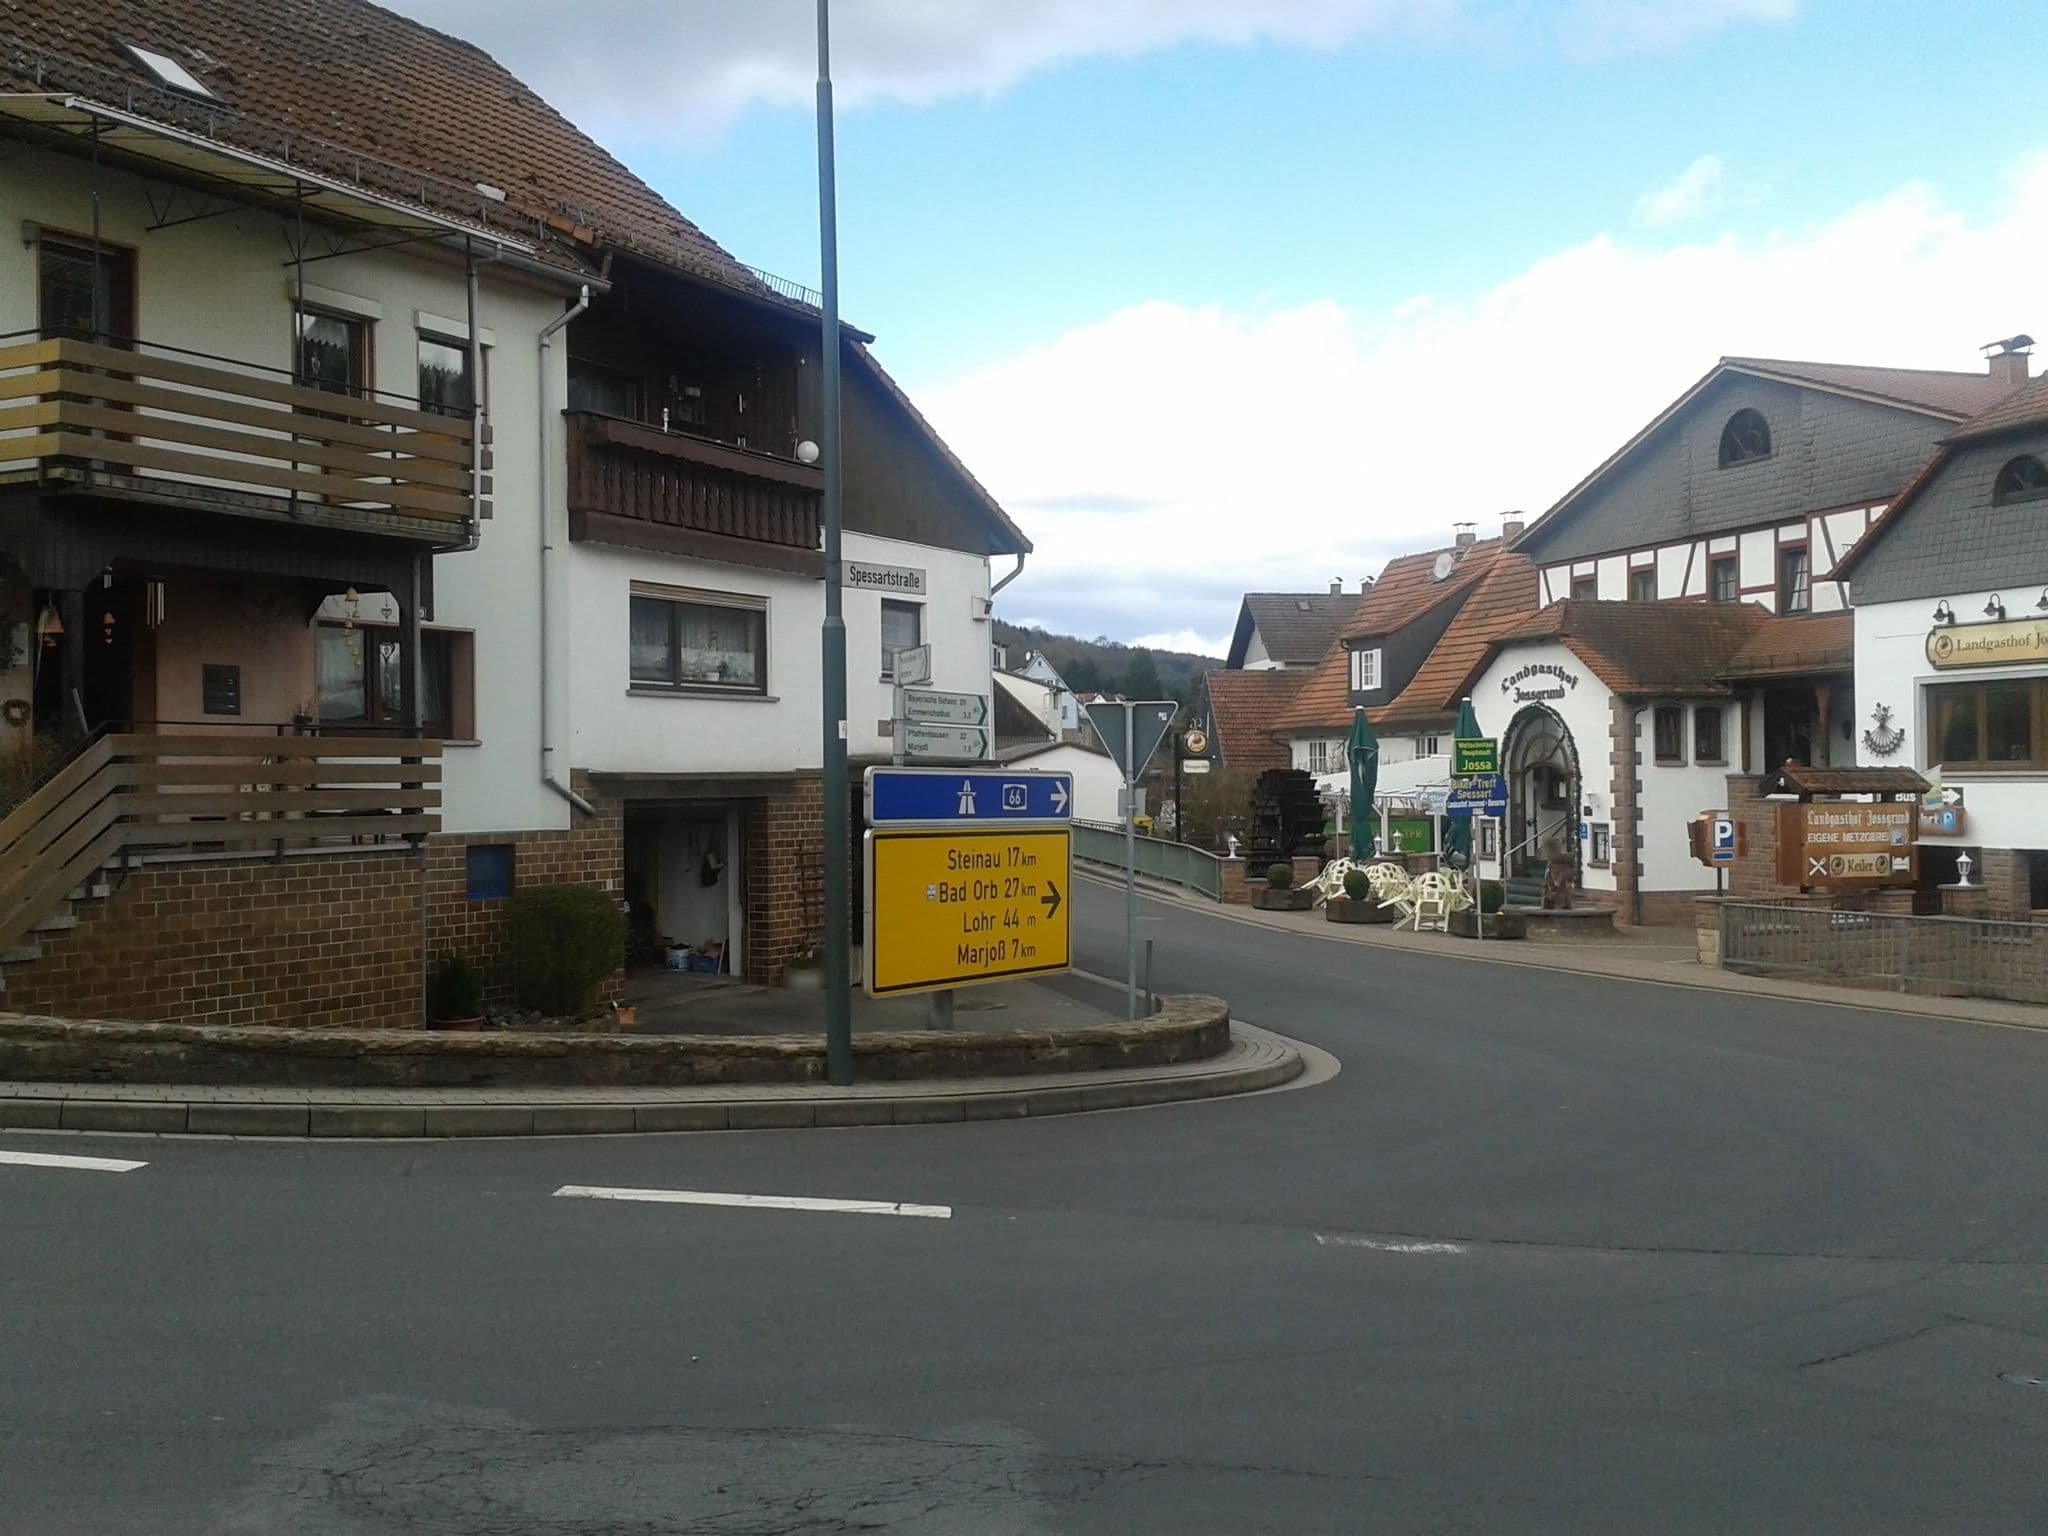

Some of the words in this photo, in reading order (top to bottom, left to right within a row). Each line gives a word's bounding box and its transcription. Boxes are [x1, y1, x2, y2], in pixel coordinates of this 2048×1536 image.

[850, 566, 920, 588] Spessartstraße
[1957, 633, 2032, 653] Landgasthof
[1501, 663, 1579, 694] Landgasthof
[1513, 683, 1565, 704] Jossgrund
[1462, 759, 1492, 770] Jossa
[1009, 791, 1021, 805] 66
[1457, 789, 1492, 799] Spessart
[1807, 811, 1862, 827] Landgasthof
[1866, 810, 1910, 827] Jossgrund
[1714, 821, 1732, 847] P
[1807, 832, 1839, 843] EIGENE
[948, 848, 1000, 870] Steinau
[1007, 847, 1019, 866] 17
[1022, 852, 1036, 866] km
[1848, 859, 1873, 872] Keiler
[939, 881, 966, 903] Bad
[974, 880, 997, 900] Orb
[1004, 878, 1019, 898] 27
[1022, 884, 1036, 897] km
[963, 910, 996, 933] Lohr
[1003, 908, 1019, 928] 44
[958, 940, 1005, 967] Marjoß
[1012, 939, 1019, 959] 7
[1021, 943, 1036, 957] km
